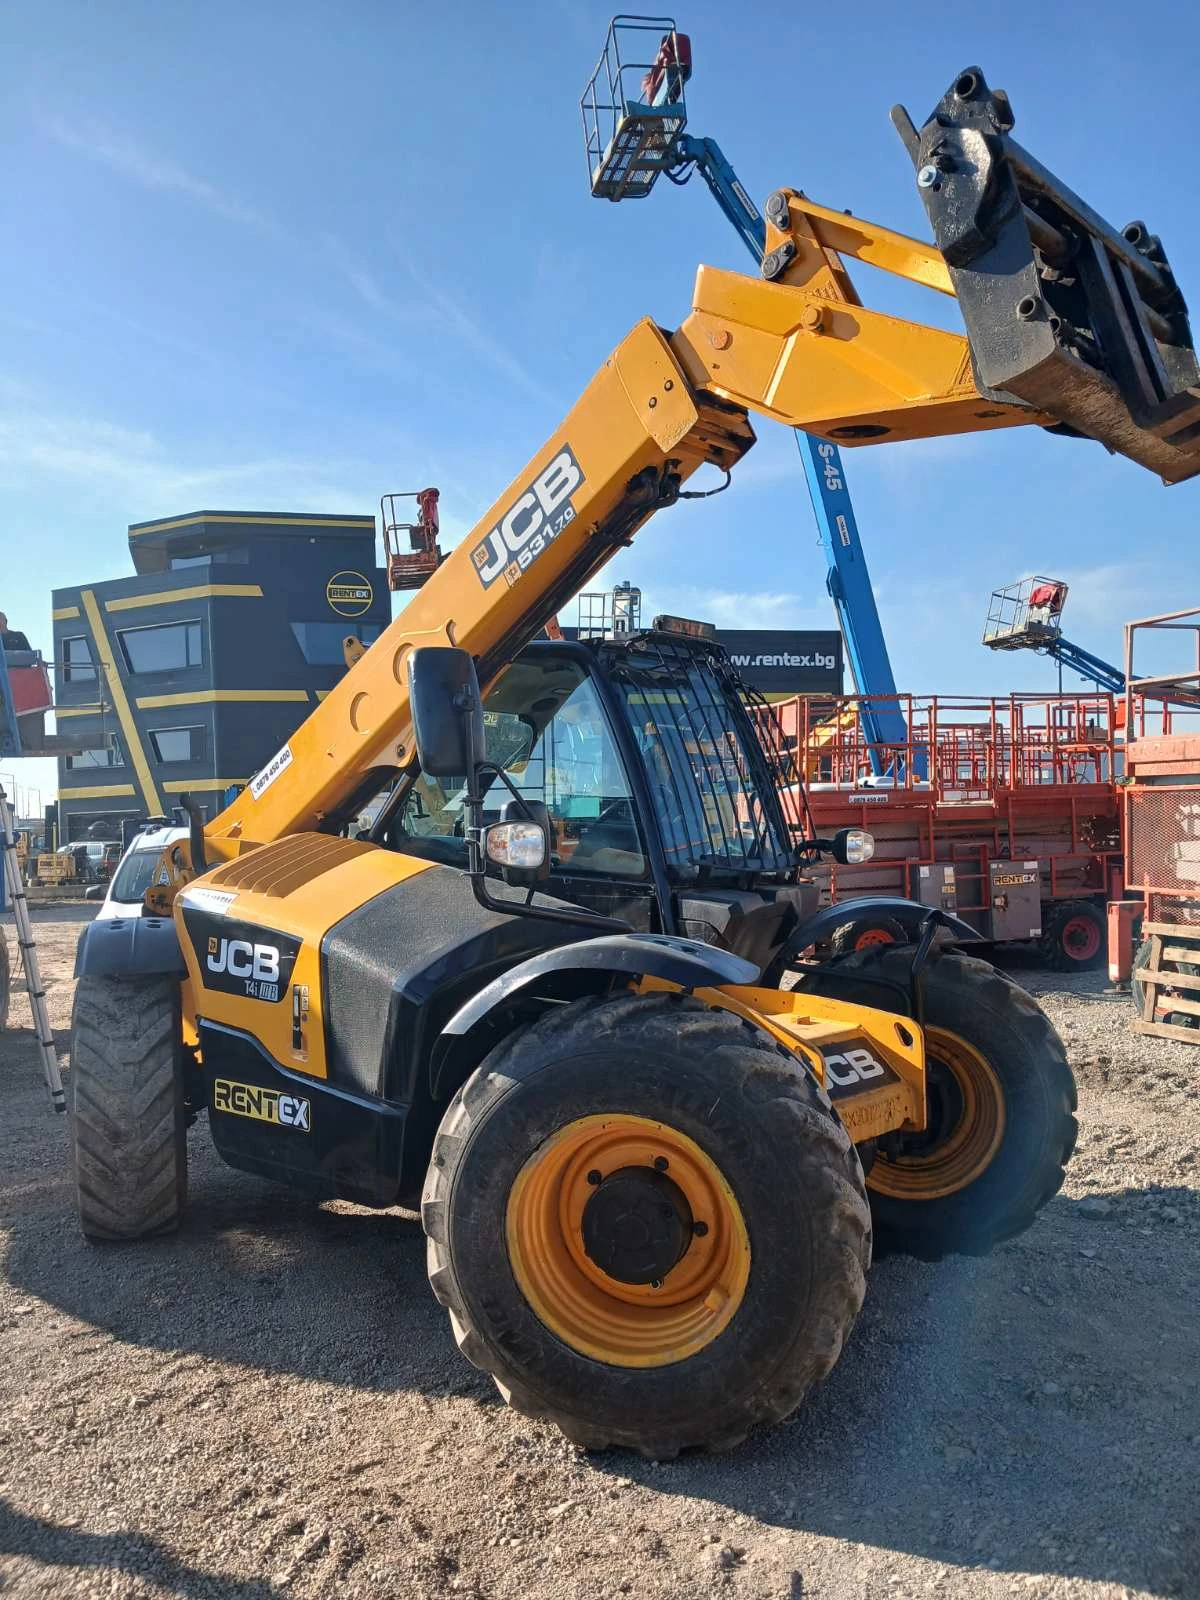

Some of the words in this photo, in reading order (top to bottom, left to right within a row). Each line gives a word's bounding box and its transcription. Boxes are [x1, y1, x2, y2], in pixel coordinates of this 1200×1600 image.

[818, 444, 842, 491] S-45
[479, 452, 580, 582] JCB
[332, 588, 369, 598] RENTEX
[994, 873, 1037, 885] RENTEX
[206, 938, 280, 983] JCB
[244, 980, 258, 996] T4i
[215, 1079, 310, 1132] RENTEX
